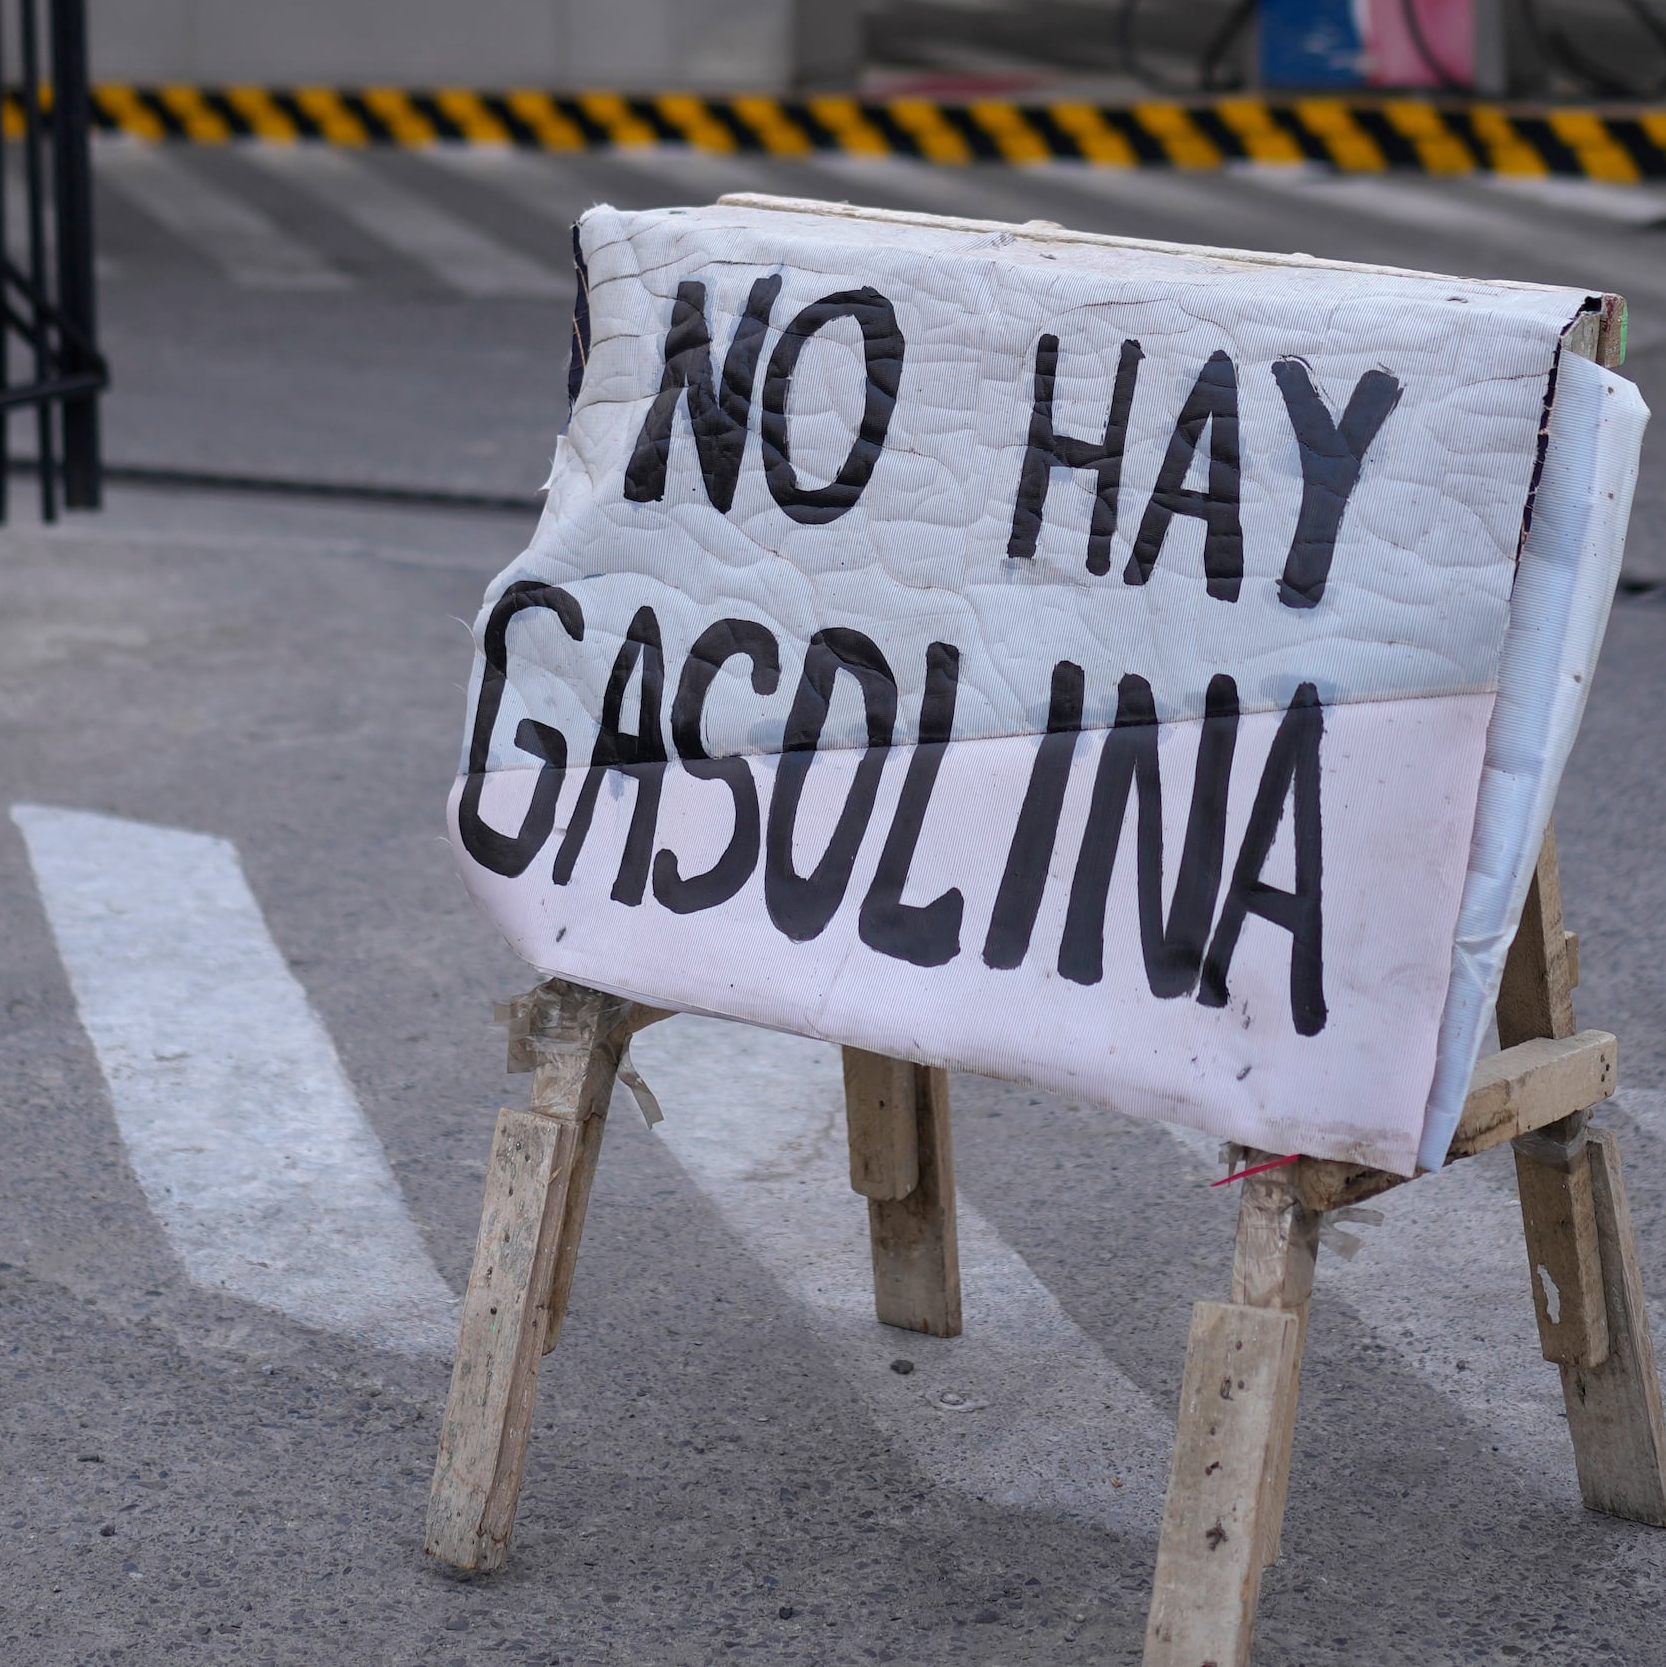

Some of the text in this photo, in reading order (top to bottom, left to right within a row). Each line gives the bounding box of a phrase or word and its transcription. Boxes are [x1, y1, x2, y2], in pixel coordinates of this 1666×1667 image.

[622, 271, 1404, 609] NO HAY
[458, 579, 1328, 1038] GASOLINA
